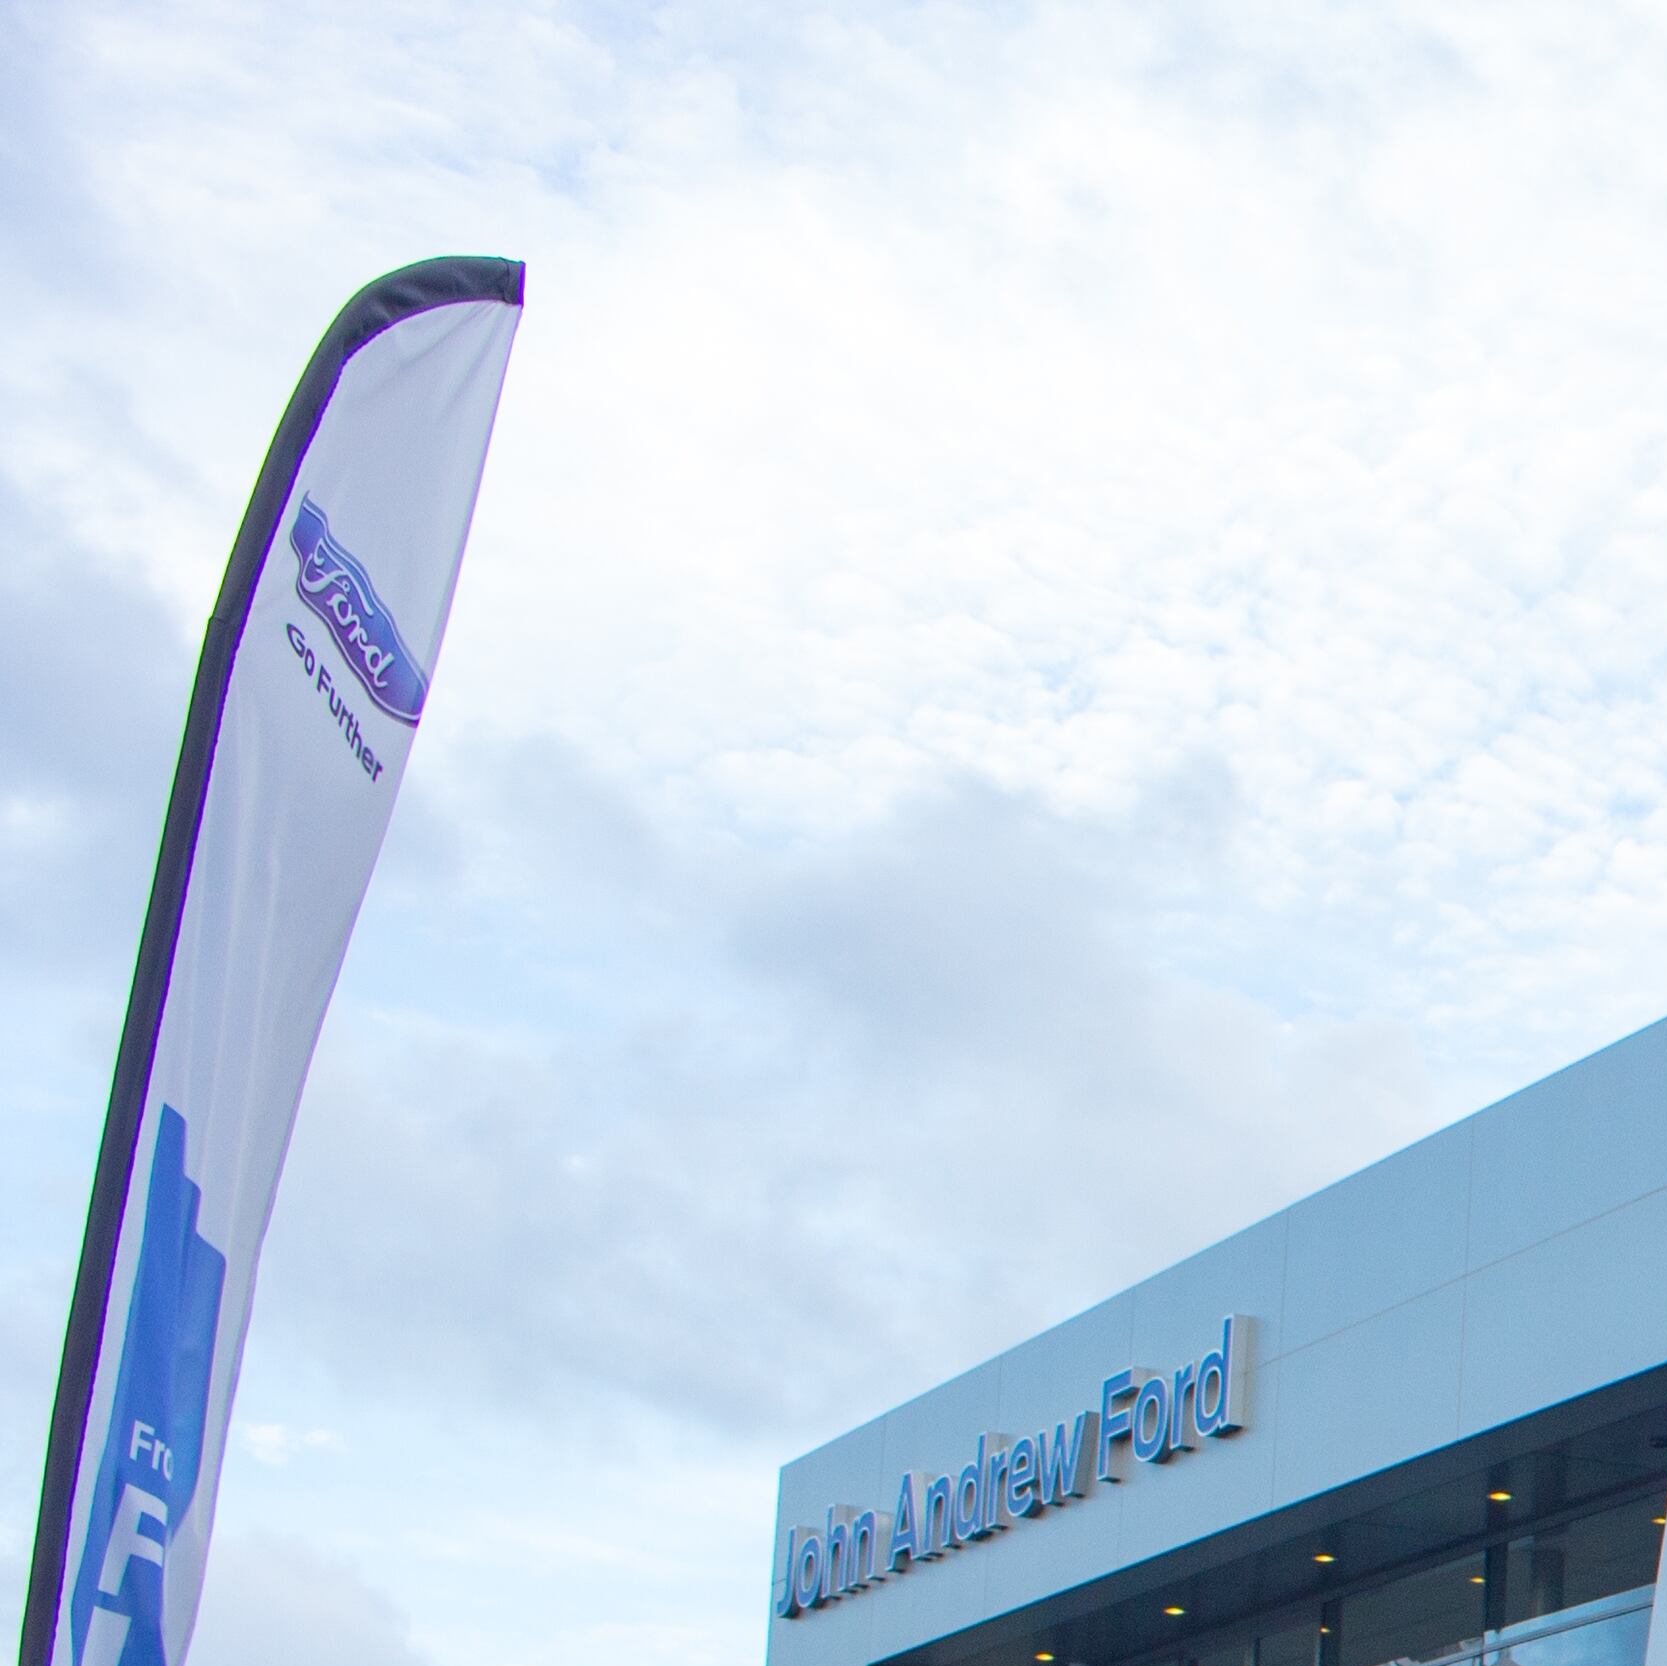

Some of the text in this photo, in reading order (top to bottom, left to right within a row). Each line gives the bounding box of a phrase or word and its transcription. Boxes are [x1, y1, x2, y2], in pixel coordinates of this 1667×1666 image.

[301, 538, 394, 688] Ford
[286, 622, 385, 783] Go Further
[777, 1314, 1246, 1619] John Andrew Ford
